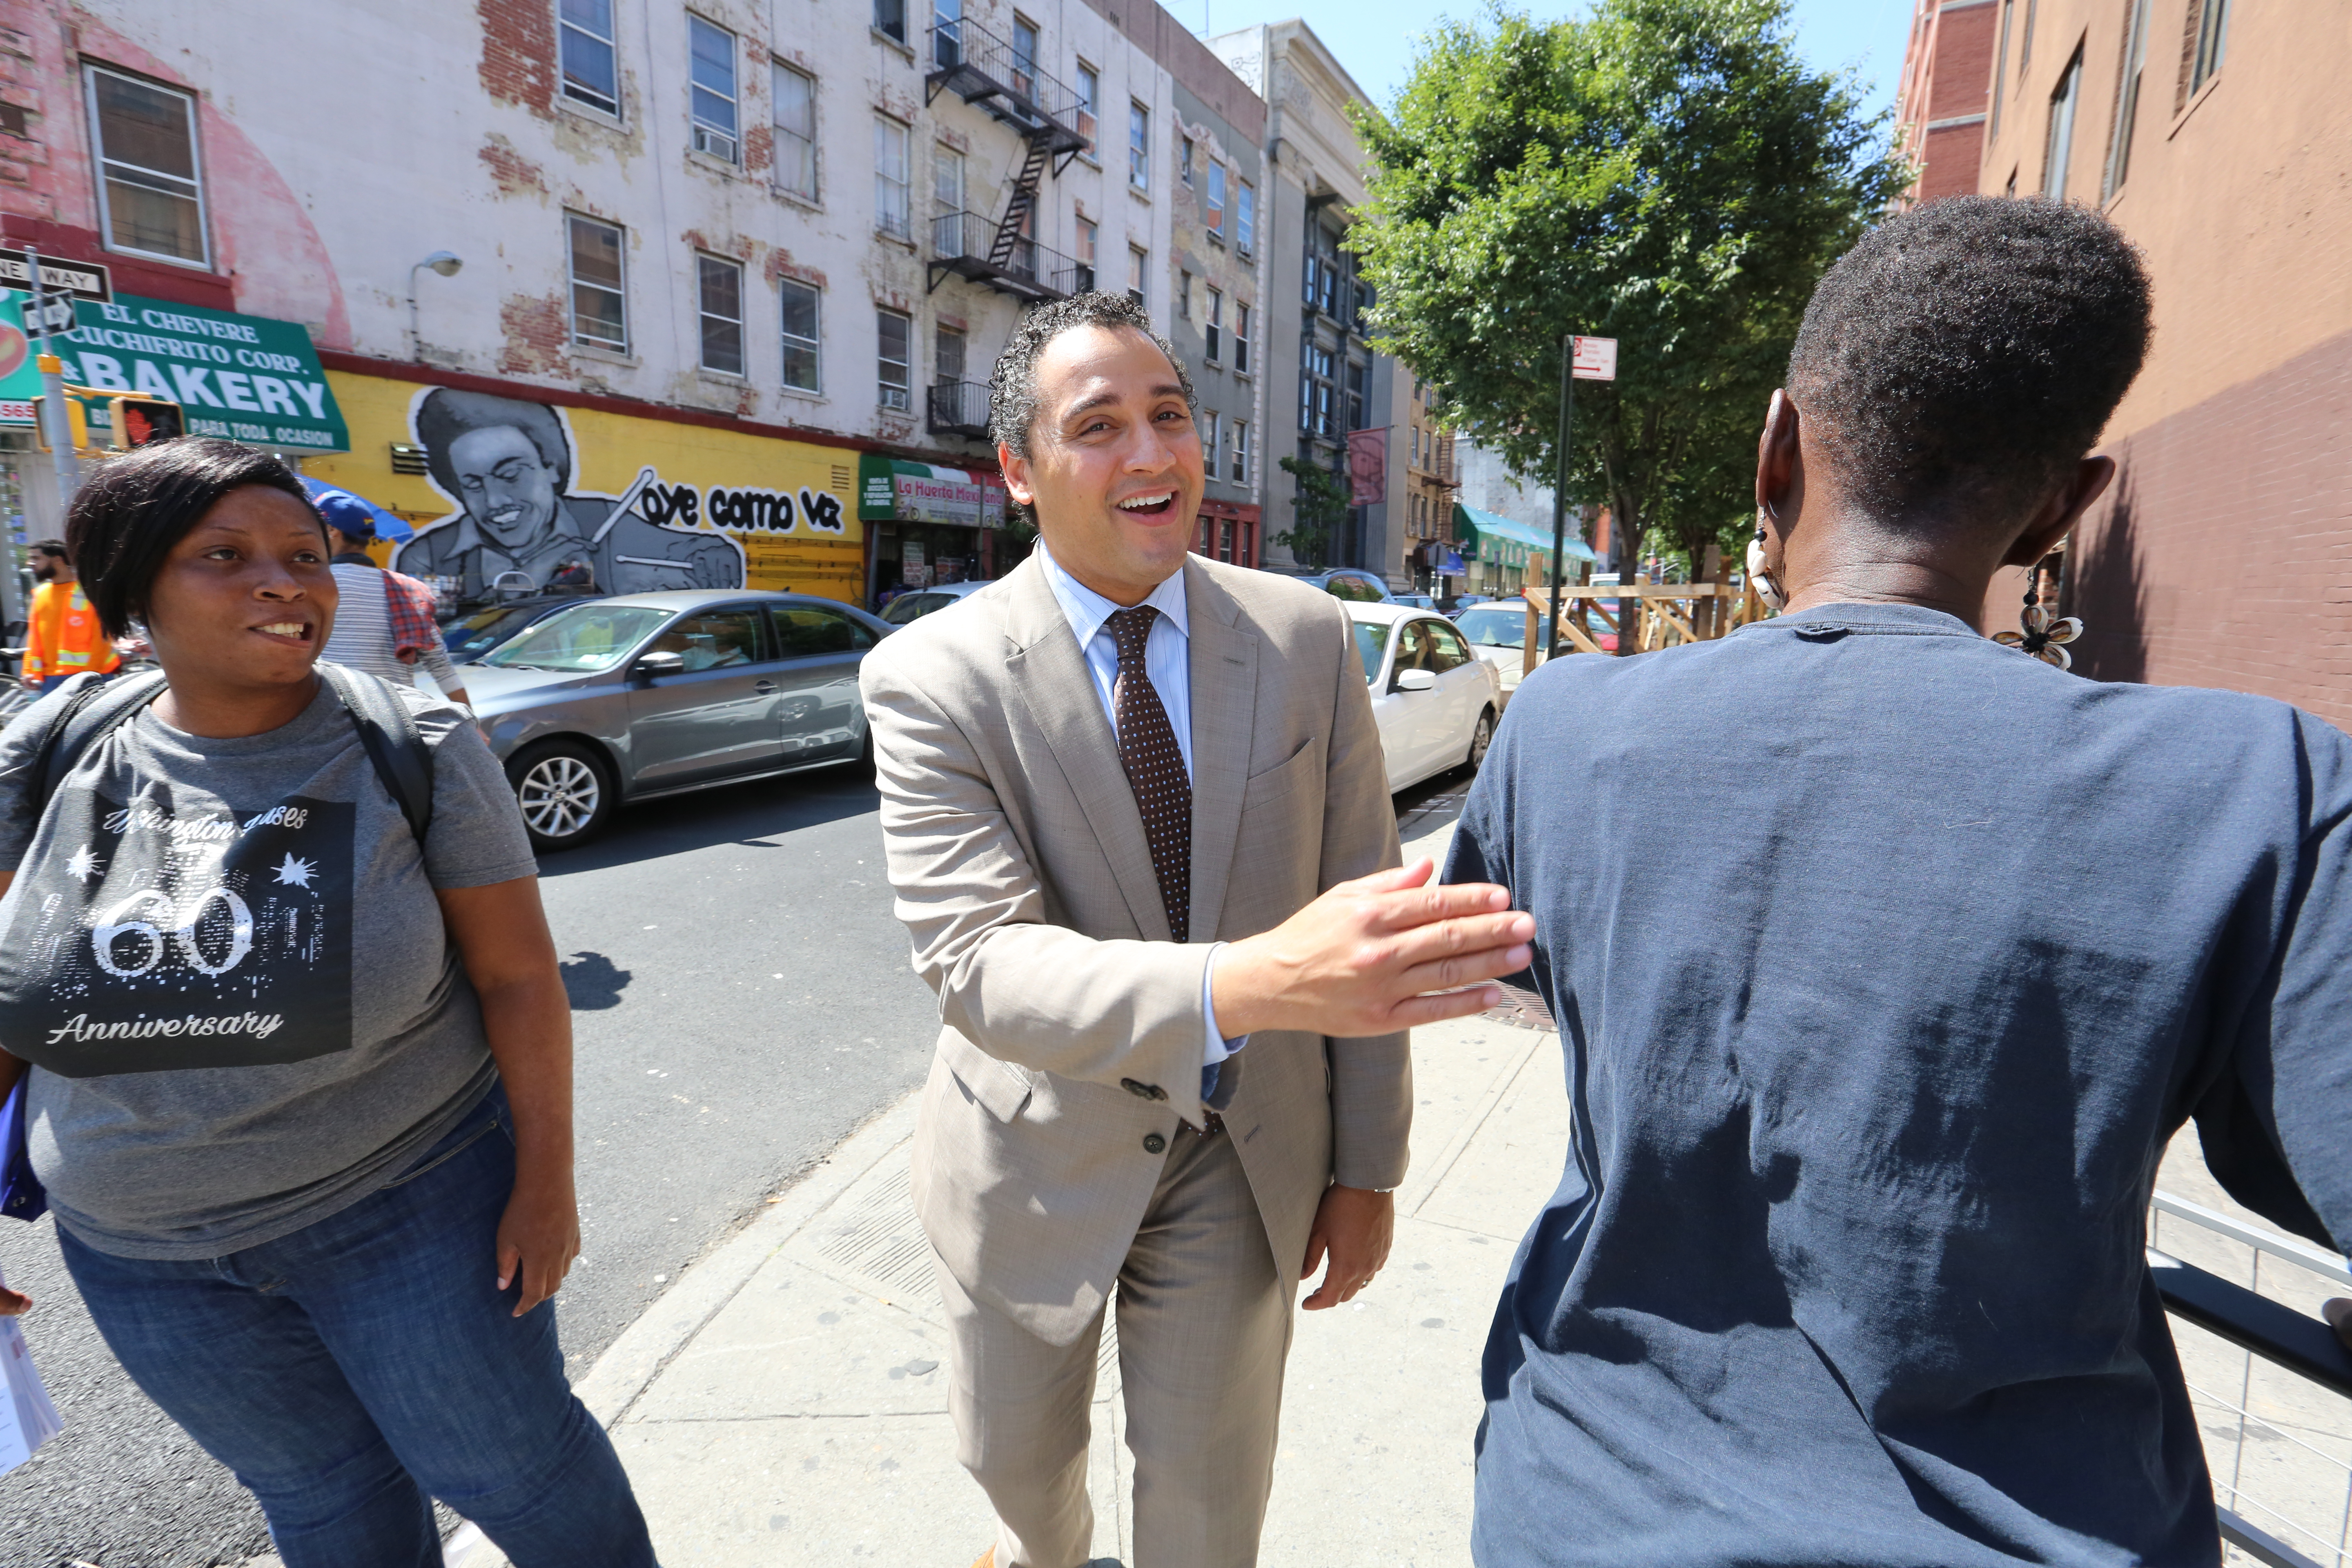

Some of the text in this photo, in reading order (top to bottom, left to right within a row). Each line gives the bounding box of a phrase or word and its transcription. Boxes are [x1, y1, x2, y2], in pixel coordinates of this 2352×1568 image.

[44, 268, 89, 288] WAY
[100, 303, 138, 325] EL
[141, 309, 261, 344] CHEVERE
[62, 325, 310, 375] CUCHIFRITO CORP.
[76, 351, 327, 420] BAKERY
[189, 418, 334, 447] PARA TODA OCASION
[898, 478, 912, 494] La
[915, 481, 953, 500] Huerta
[956, 486, 1004, 504] Mexiana
[92, 886, 254, 978] 60
[46, 1011, 284, 1046] Anniversary
